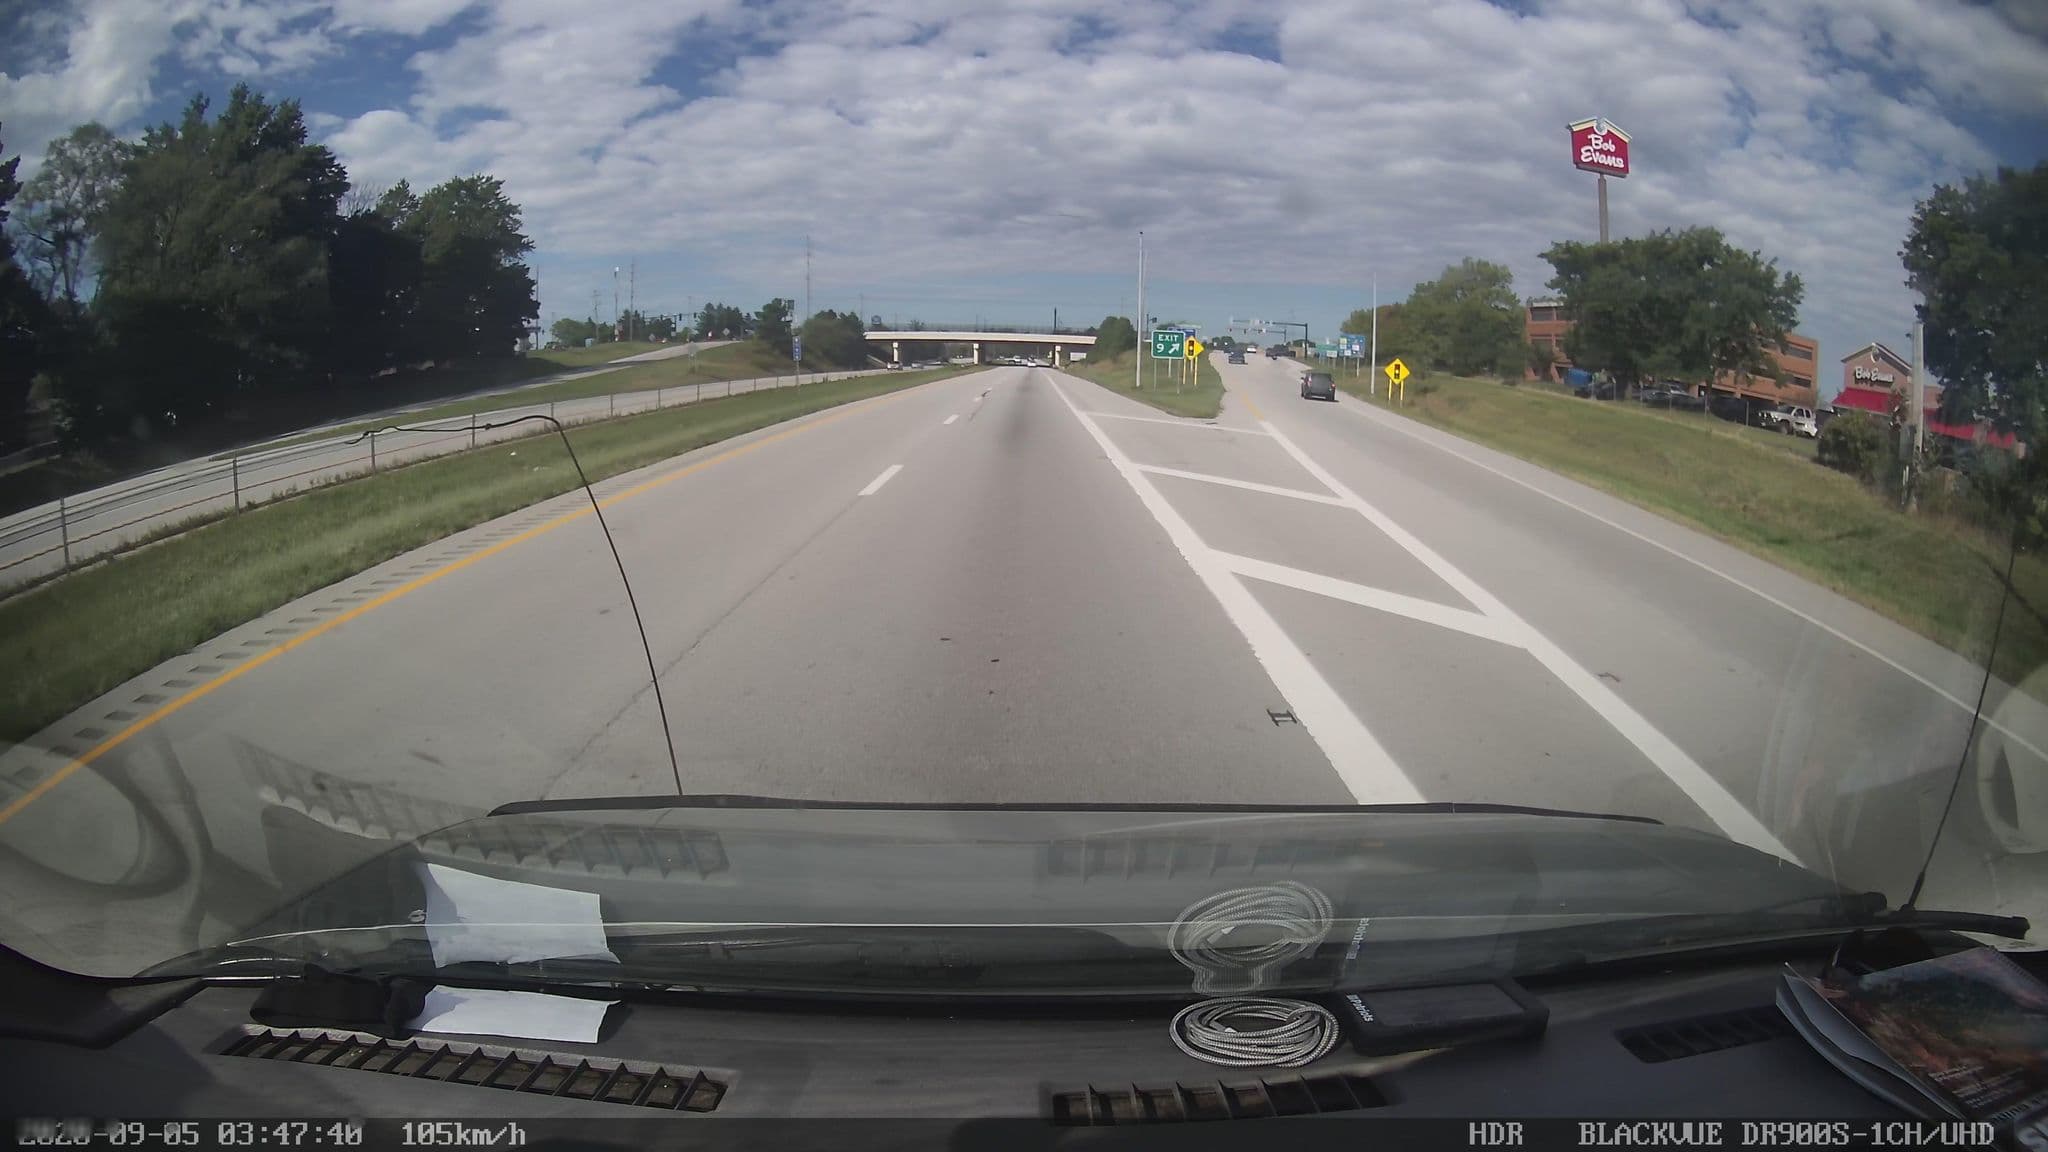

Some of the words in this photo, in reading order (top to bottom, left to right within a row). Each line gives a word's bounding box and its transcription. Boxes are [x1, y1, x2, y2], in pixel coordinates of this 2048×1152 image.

[1588, 133, 1615, 152] Bob
[1580, 145, 1624, 168] Evans
[1158, 334, 1179, 342] EXIT
[1156, 343, 1165, 353] 9
